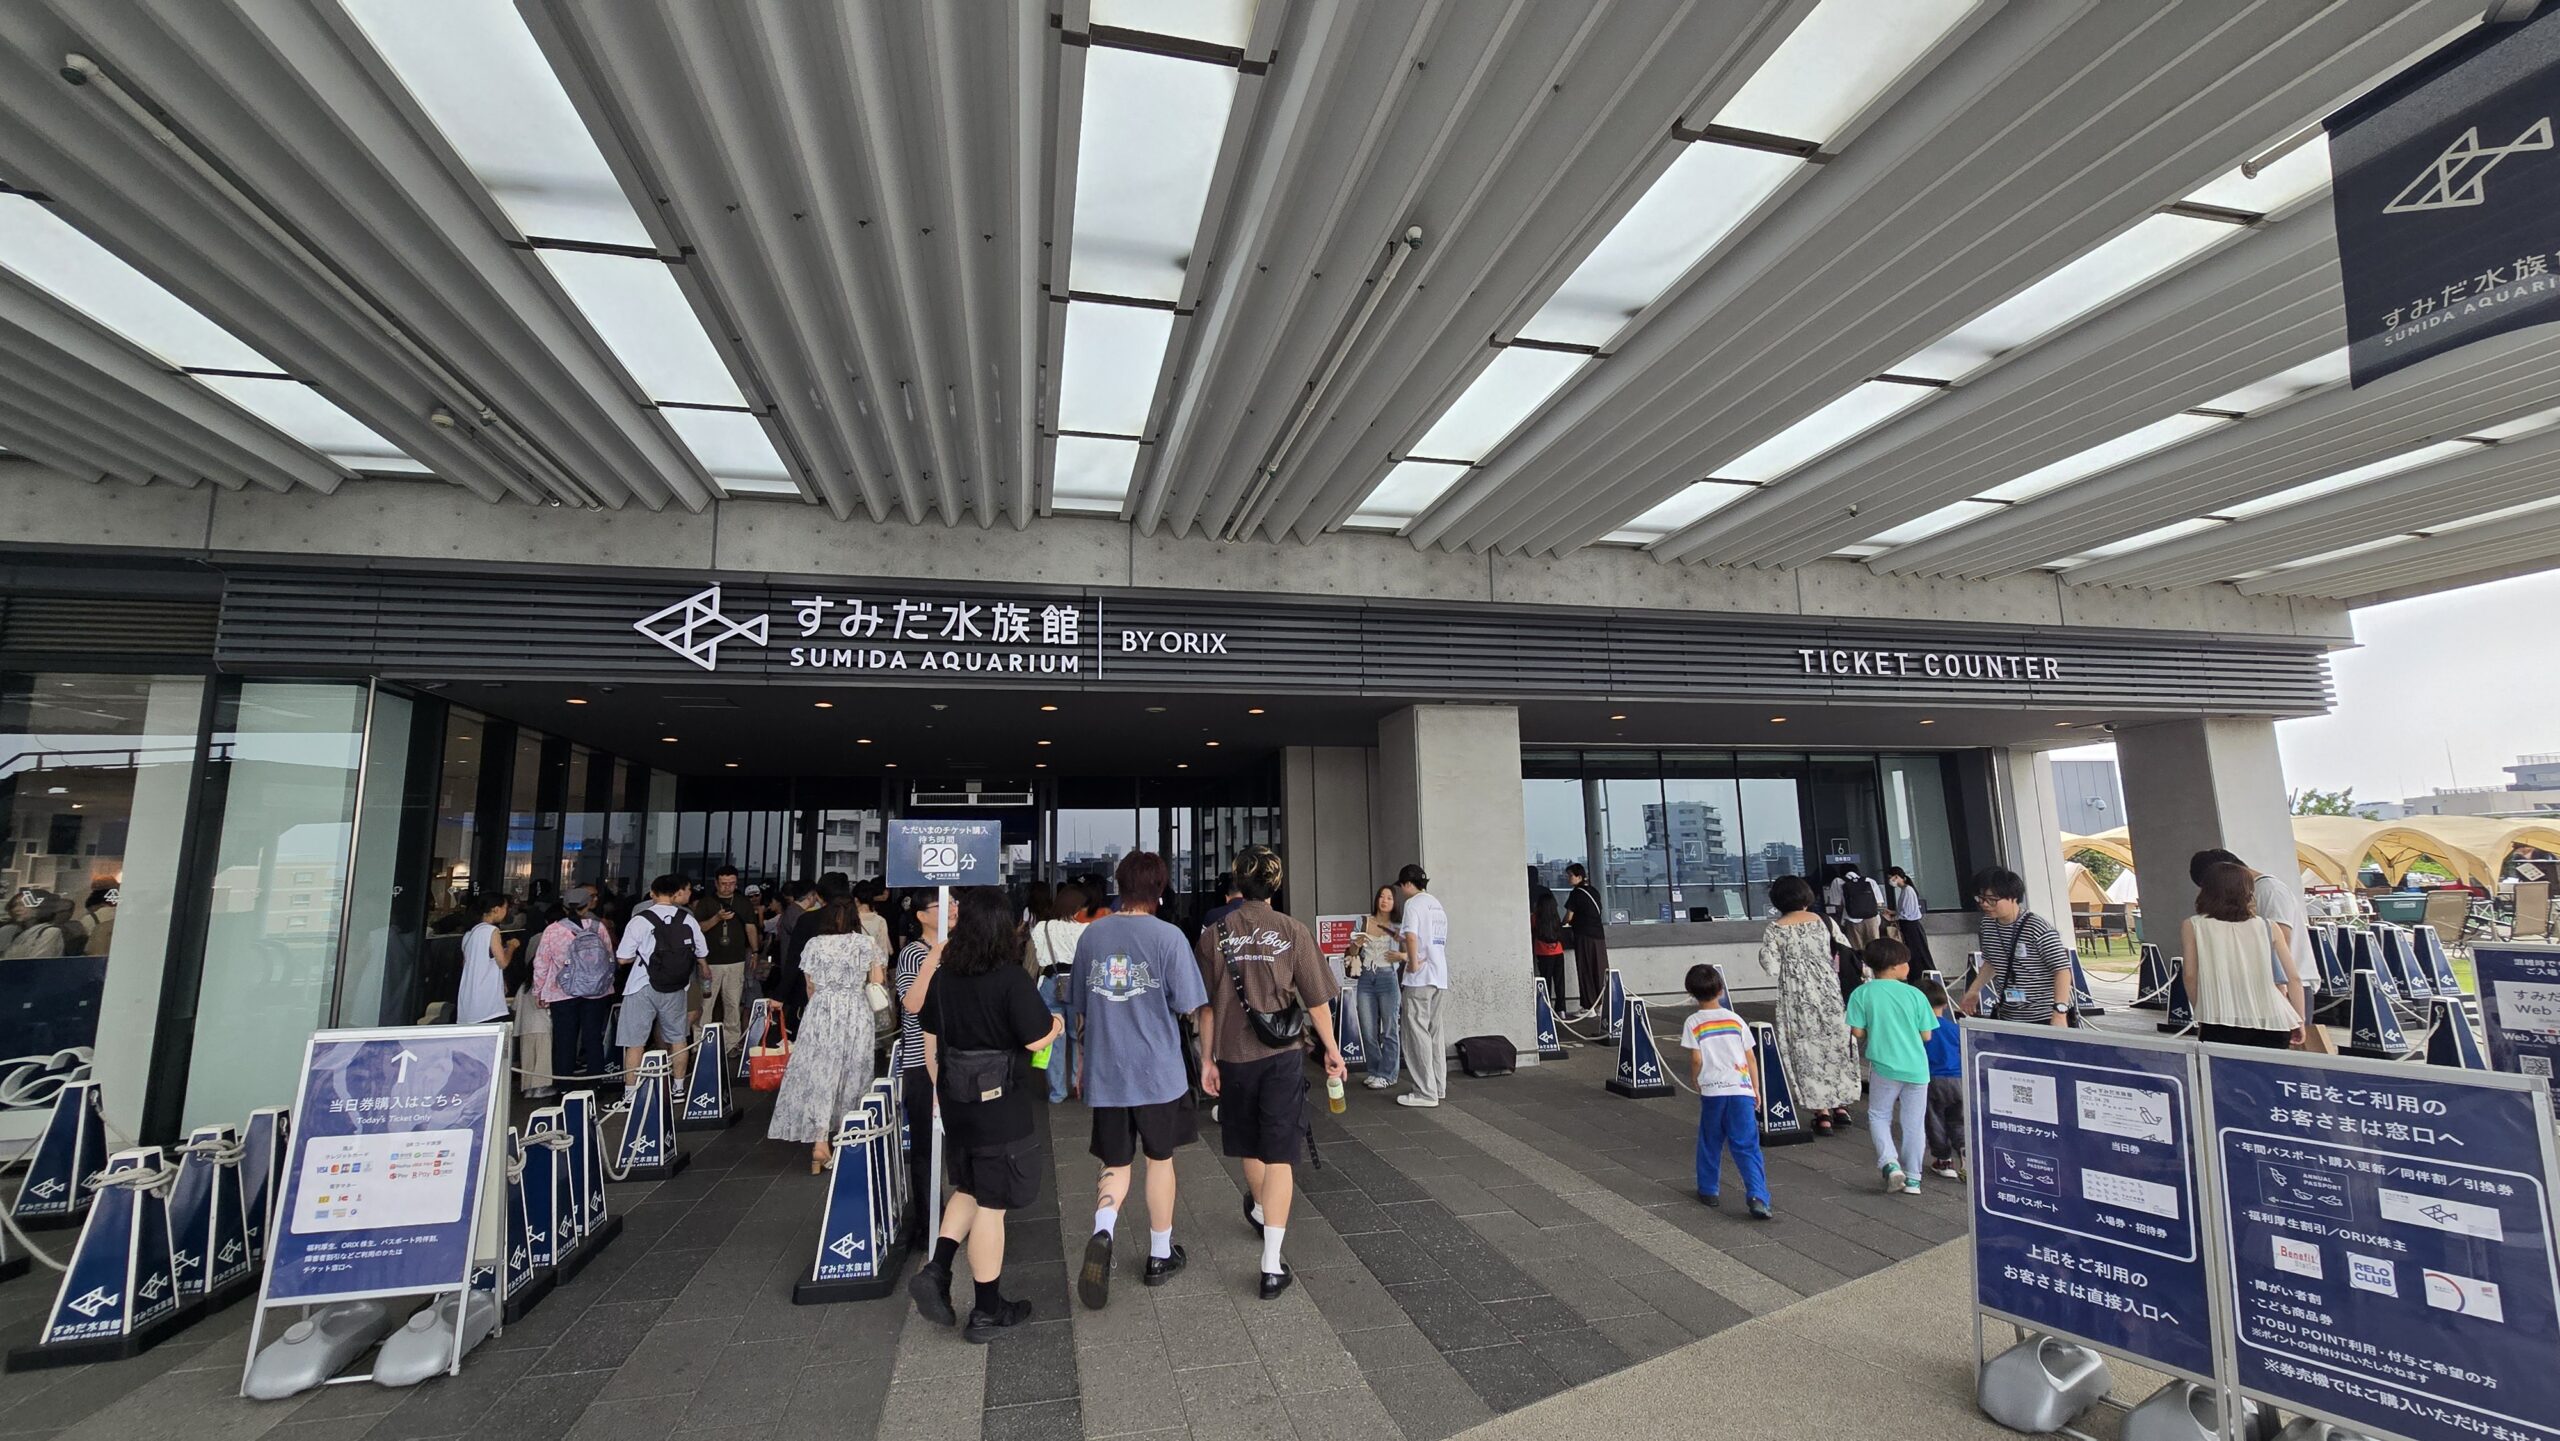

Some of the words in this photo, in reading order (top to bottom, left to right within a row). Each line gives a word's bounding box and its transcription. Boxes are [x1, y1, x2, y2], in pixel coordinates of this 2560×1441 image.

[2381, 250, 2560, 332] すみだ水族
[2384, 310, 2456, 346] SUMIDA
[790, 595, 1080, 646] すみだ水族館
[1121, 630, 1154, 654] BY
[1159, 631, 1228, 655] ORIX
[790, 647, 907, 669] SUMIDA
[920, 651, 1080, 675] AQUARIUM
[1799, 649, 1909, 676] TICKET
[1924, 653, 2060, 680] COUNTER
[922, 847, 957, 867] 20
[960, 853, 977, 871] 分
[1689, 845, 1697, 858] 4
[1838, 842, 1845, 855] 6
[1256, 930, 1292, 955] Boy
[2514, 1003, 2552, 1016] Web
[2501, 1031, 2530, 1042] Web
[2532, 1034, 2560, 1046] 入場
[328, 1092, 463, 1114] 当日券購入はこちら
[2275, 1079, 2448, 1117] 下記をご利用の
[356, 1114, 387, 1126] Today's
[389, 1113, 412, 1123] Ticket
[412, 1113, 431, 1124] Only
[1991, 1120, 2058, 1139] 日時指定チケット
[2269, 1106, 2465, 1147] お客さまは窓口へ
[2111, 1141, 2141, 1155] 当日券
[620, 1155, 660, 1165] すだ水族館
[2027, 1163, 2054, 1173] PASSPORT
[2302, 1173, 2334, 1184] ANNUAL
[2303, 1179, 2342, 1192] PASSPORT
[1997, 1191, 2059, 1213] 年間パスポート
[2096, 1213, 2168, 1240] 入場券・招待券
[2279, 1245, 2318, 1265] Benefit
[820, 1261, 871, 1275] すみだ水族館
[2026, 1244, 2149, 1288] 上記をご利用の
[2353, 1262, 2390, 1277] RELO
[2354, 1272, 2392, 1287] CLUB
[2003, 1264, 2180, 1326] お客さまは直接入口へ
[52, 1318, 122, 1337] すみだ水族館
[2263, 1357, 2543, 1441] ※券売機ではご購入いただけませ
